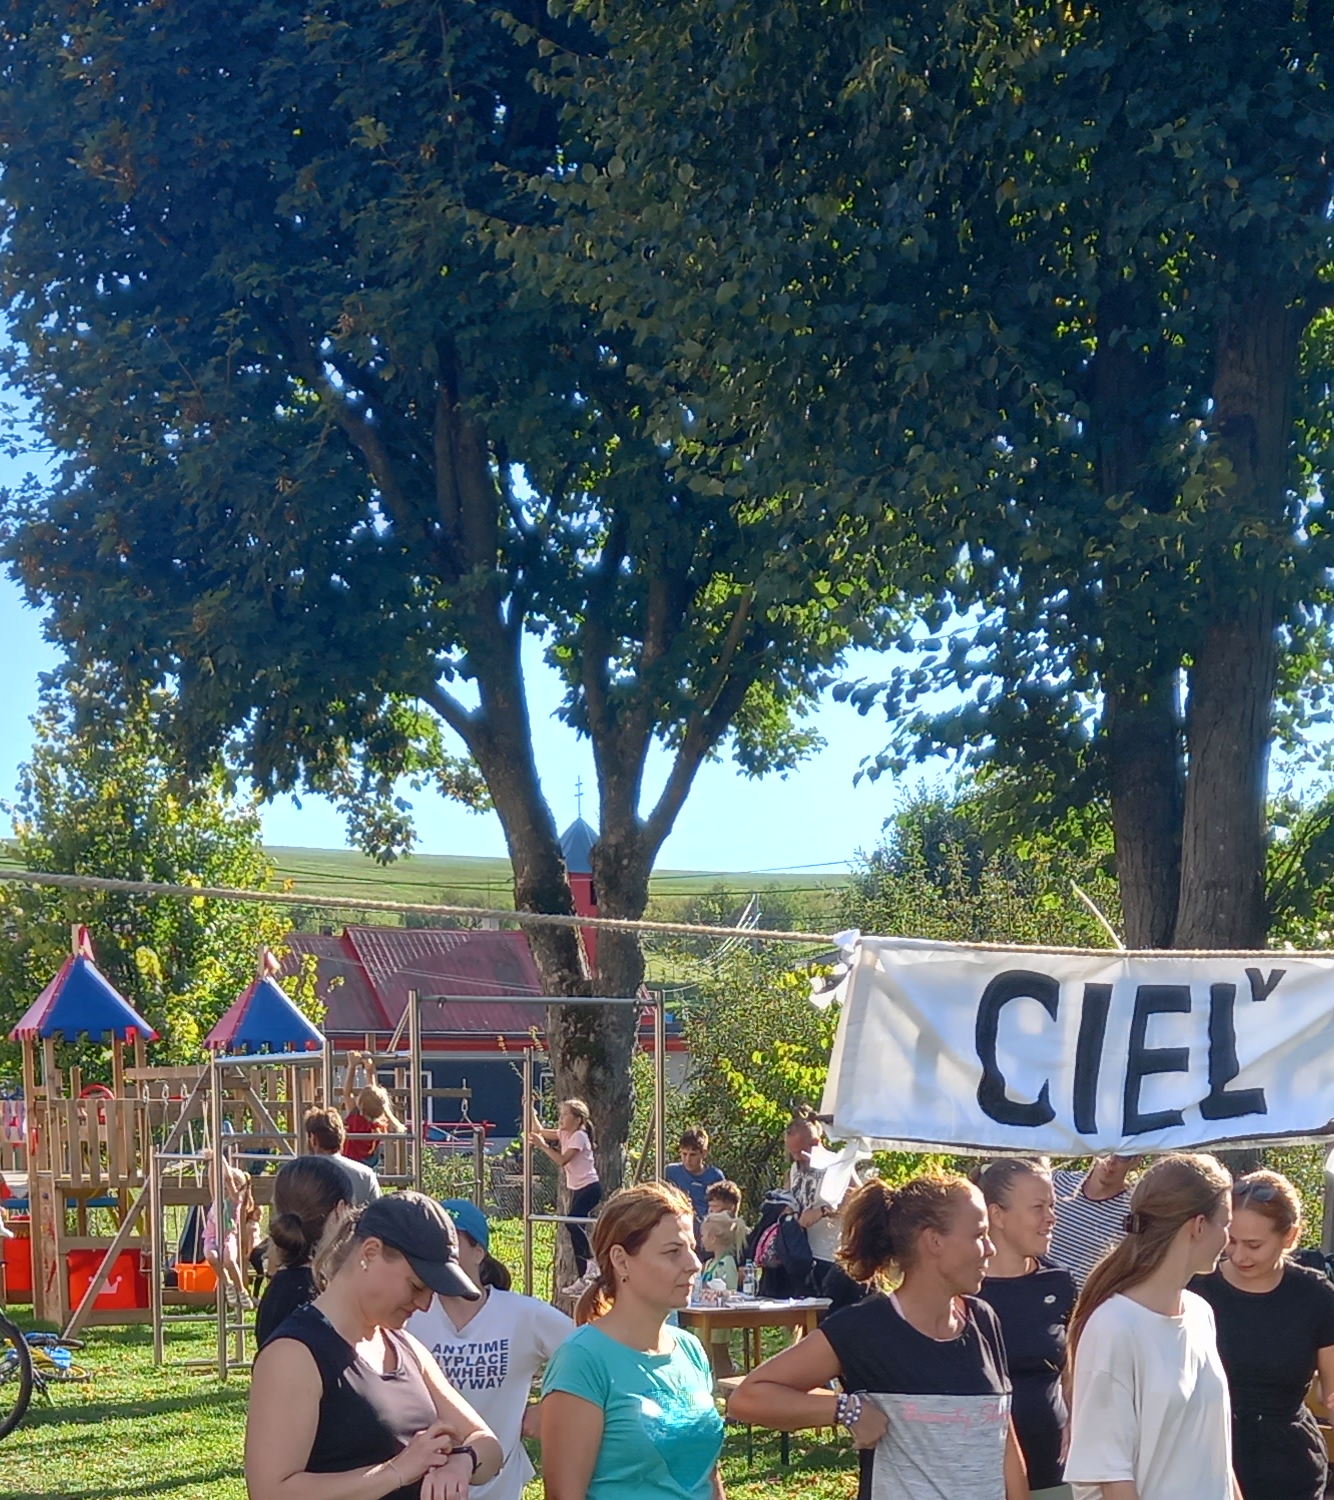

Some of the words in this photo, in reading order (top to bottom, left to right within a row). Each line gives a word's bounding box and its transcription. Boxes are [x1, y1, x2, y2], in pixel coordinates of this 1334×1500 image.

[975, 966, 1286, 1136] CIEĽ
[432, 1338, 509, 1355] ANYTIME
[441, 1364, 509, 1378] WHERE
